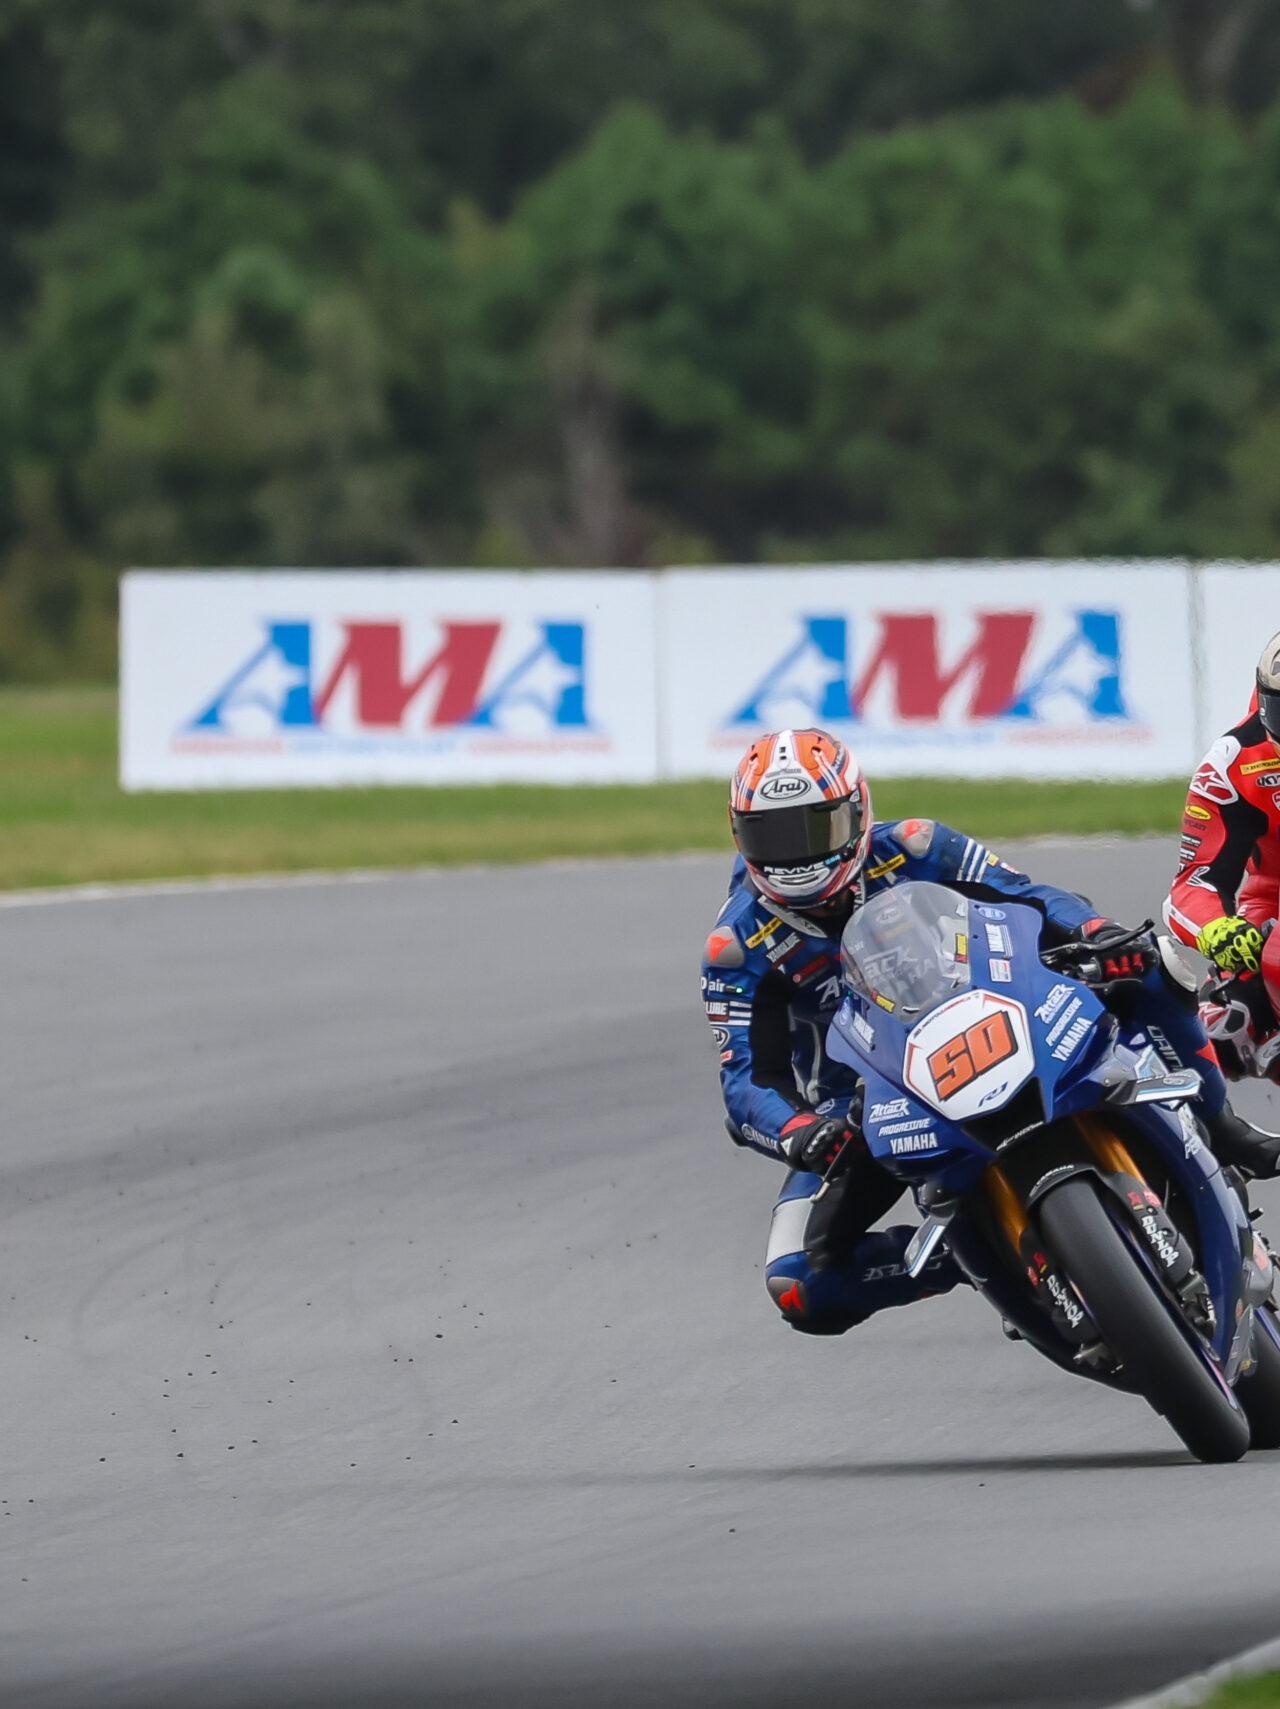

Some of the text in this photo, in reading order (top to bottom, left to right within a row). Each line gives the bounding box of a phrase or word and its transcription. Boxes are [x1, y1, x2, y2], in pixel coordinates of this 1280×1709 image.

[178, 616, 599, 732] AMA
[718, 608, 1140, 724] AMA
[766, 778, 803, 796] Arai
[763, 861, 825, 875] REVIVE
[926, 1010, 1018, 1102] 50
[1051, 1017, 1093, 1062] YAMAHA
[869, 1098, 911, 1118] Attack
[890, 1132, 938, 1154] YAMAHA
